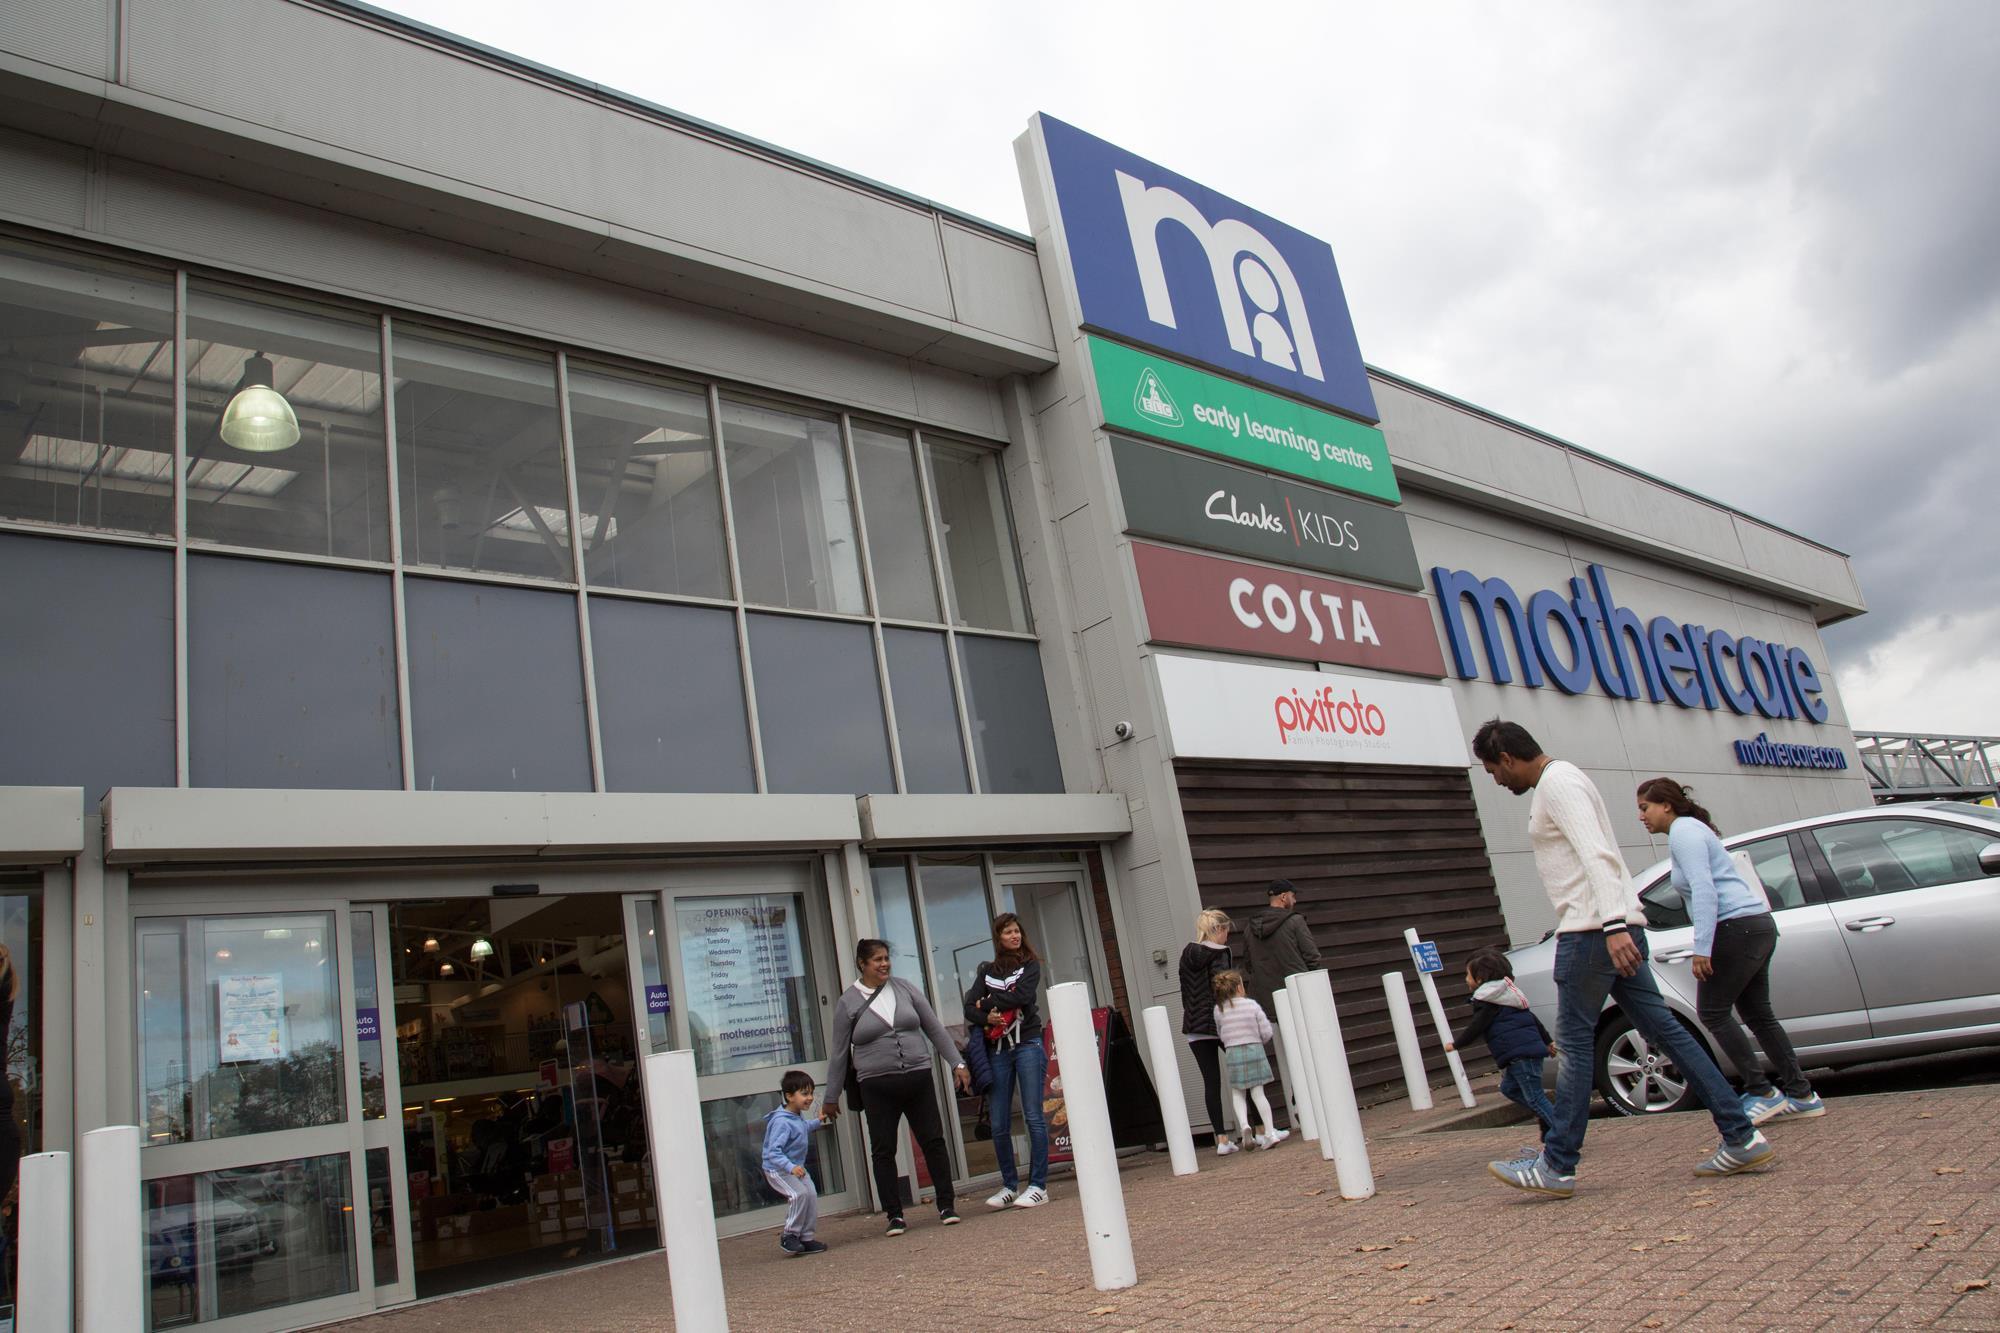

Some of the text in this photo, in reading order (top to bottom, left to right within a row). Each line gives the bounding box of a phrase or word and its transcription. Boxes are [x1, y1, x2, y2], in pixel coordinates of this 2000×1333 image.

[1193, 402, 1373, 472] early learning centre
[1298, 508, 1359, 551] KIDS
[1229, 577, 1381, 646] COSTA
[1431, 564, 1829, 725] mothercare
[1275, 686, 1386, 745] pixifoto
[1734, 732, 1847, 770] mothercare.com
[705, 907, 749, 918] OPENING
[704, 927, 729, 935] Monday
[712, 982, 738, 990] Saturday
[714, 993, 736, 1001] Sunday
[356, 1026, 376, 1035] oors
[1055, 1136, 1072, 1146] COS
